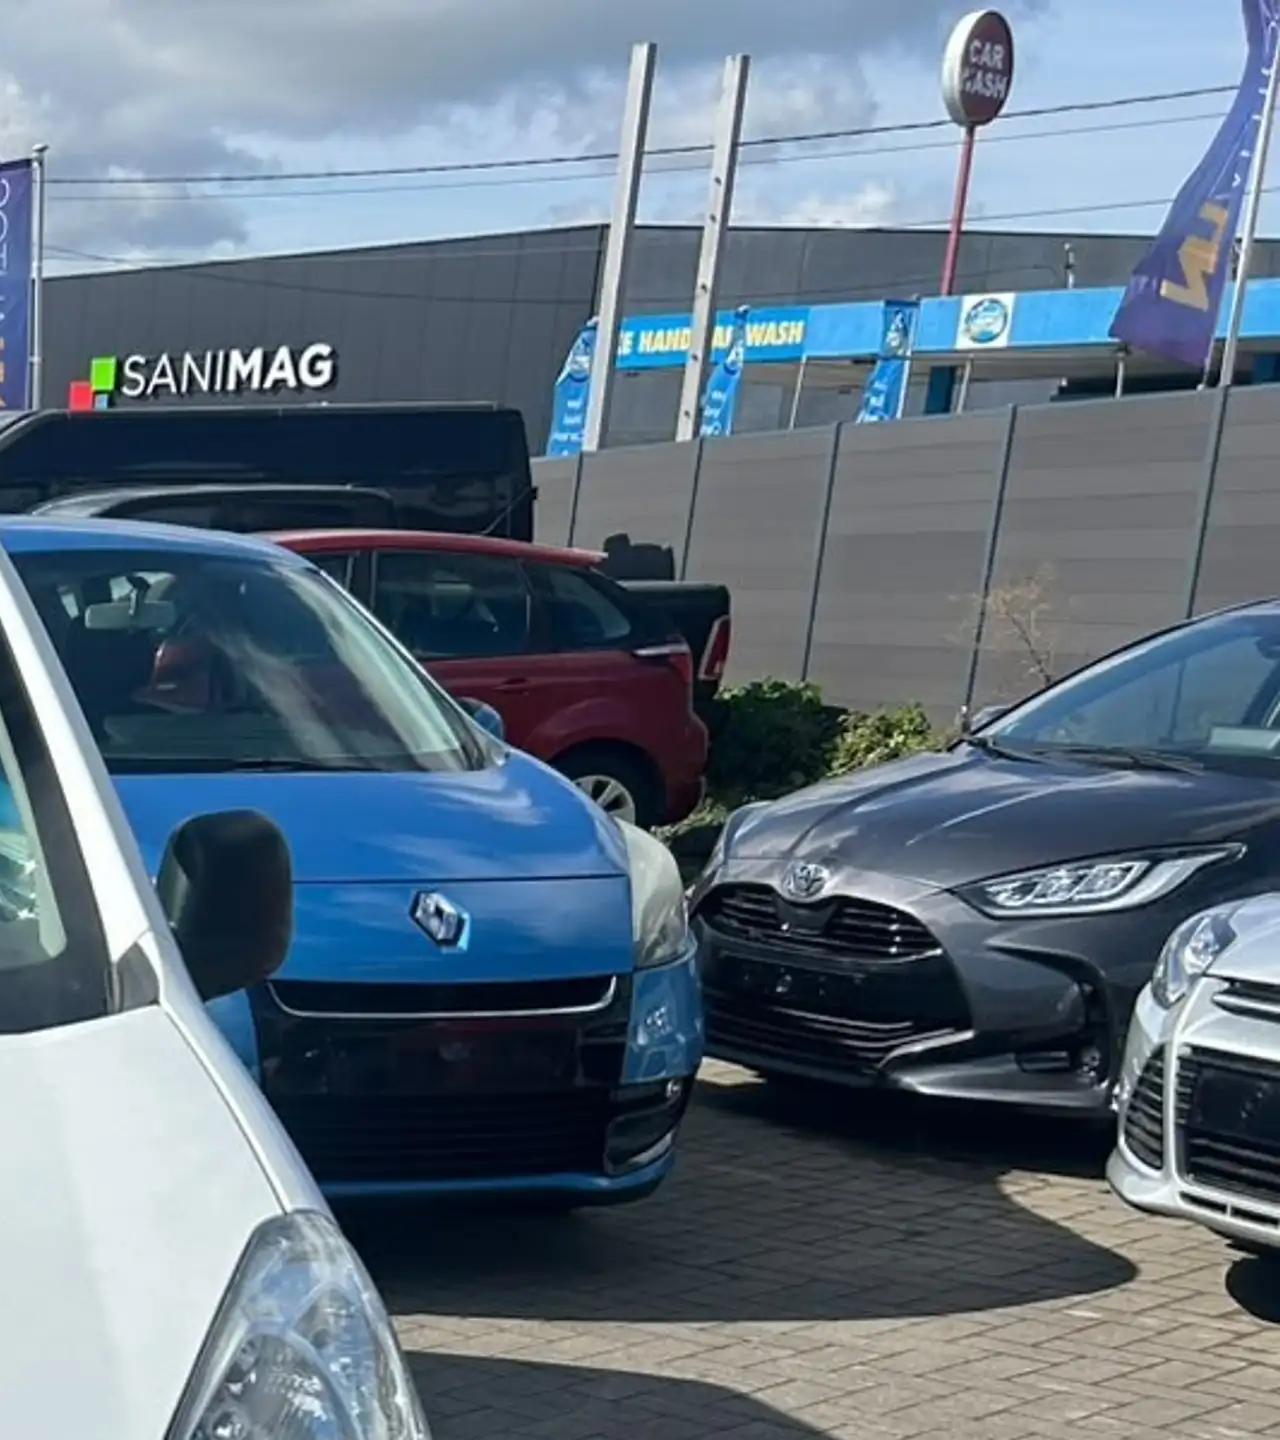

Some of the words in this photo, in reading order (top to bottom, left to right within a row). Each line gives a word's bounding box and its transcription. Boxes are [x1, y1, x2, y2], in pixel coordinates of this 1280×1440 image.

[970, 39, 1004, 69] CAR
[746, 321, 804, 347] WASH
[121, 343, 333, 396] SANIMAG
